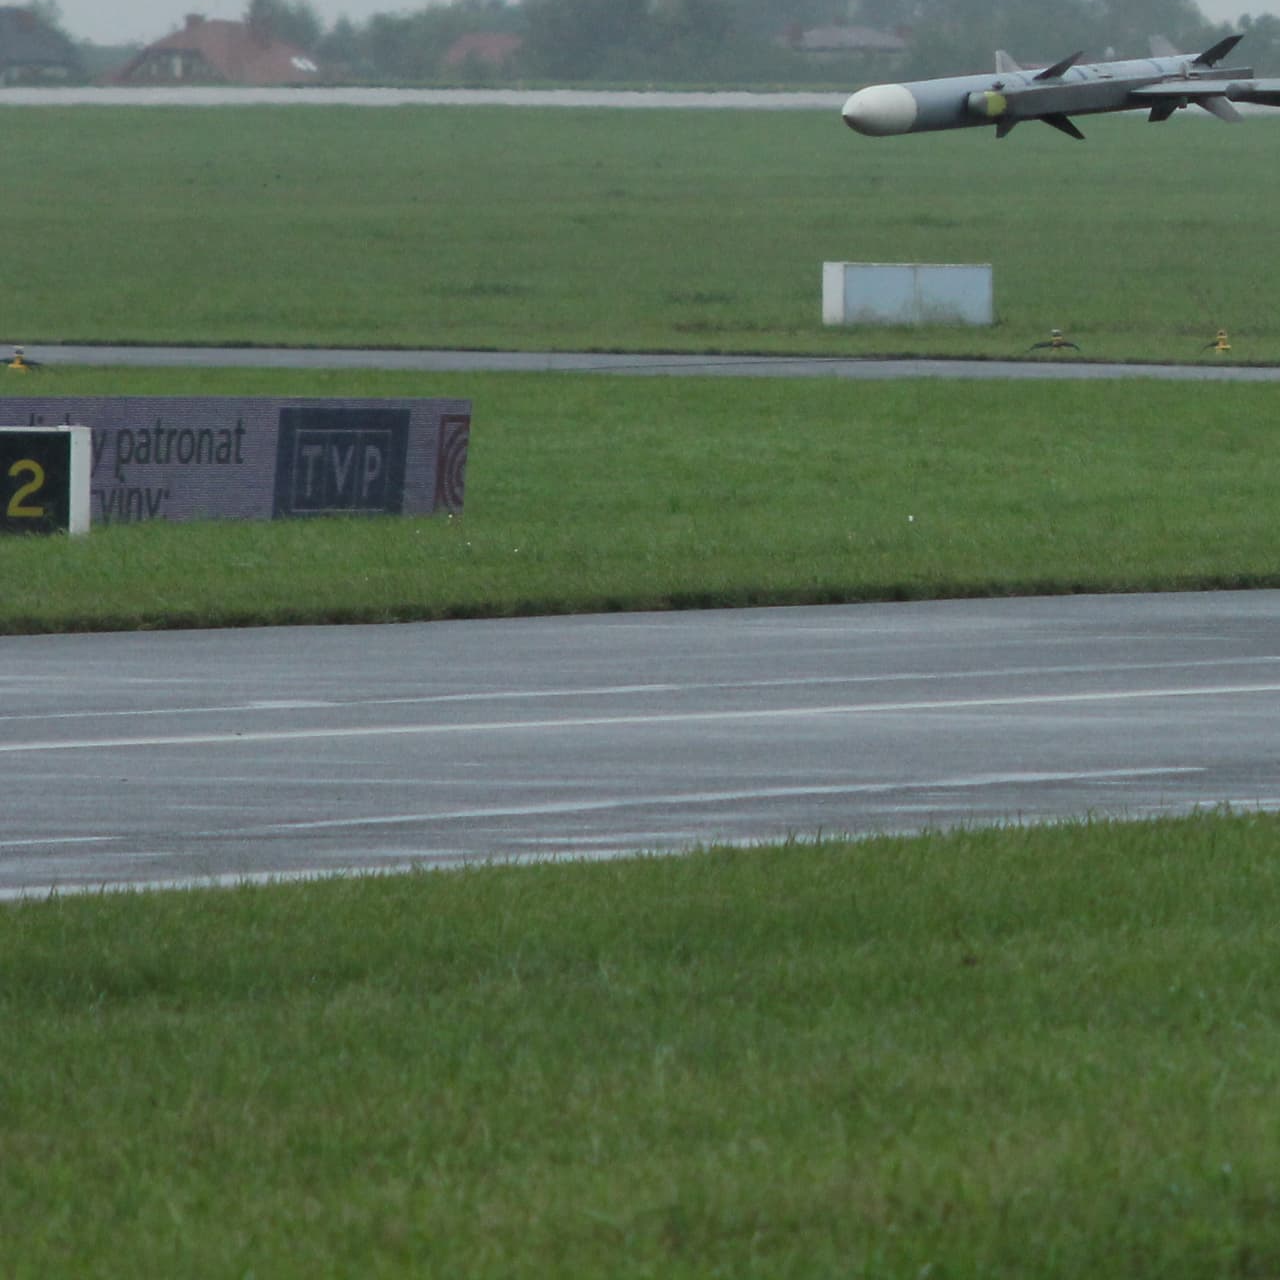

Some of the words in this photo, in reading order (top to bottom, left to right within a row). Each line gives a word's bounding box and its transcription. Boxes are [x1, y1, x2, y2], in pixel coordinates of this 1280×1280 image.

[114, 417, 247, 478] patronat
[302, 444, 381, 497] TVP
[6, 458, 46, 517] 2
